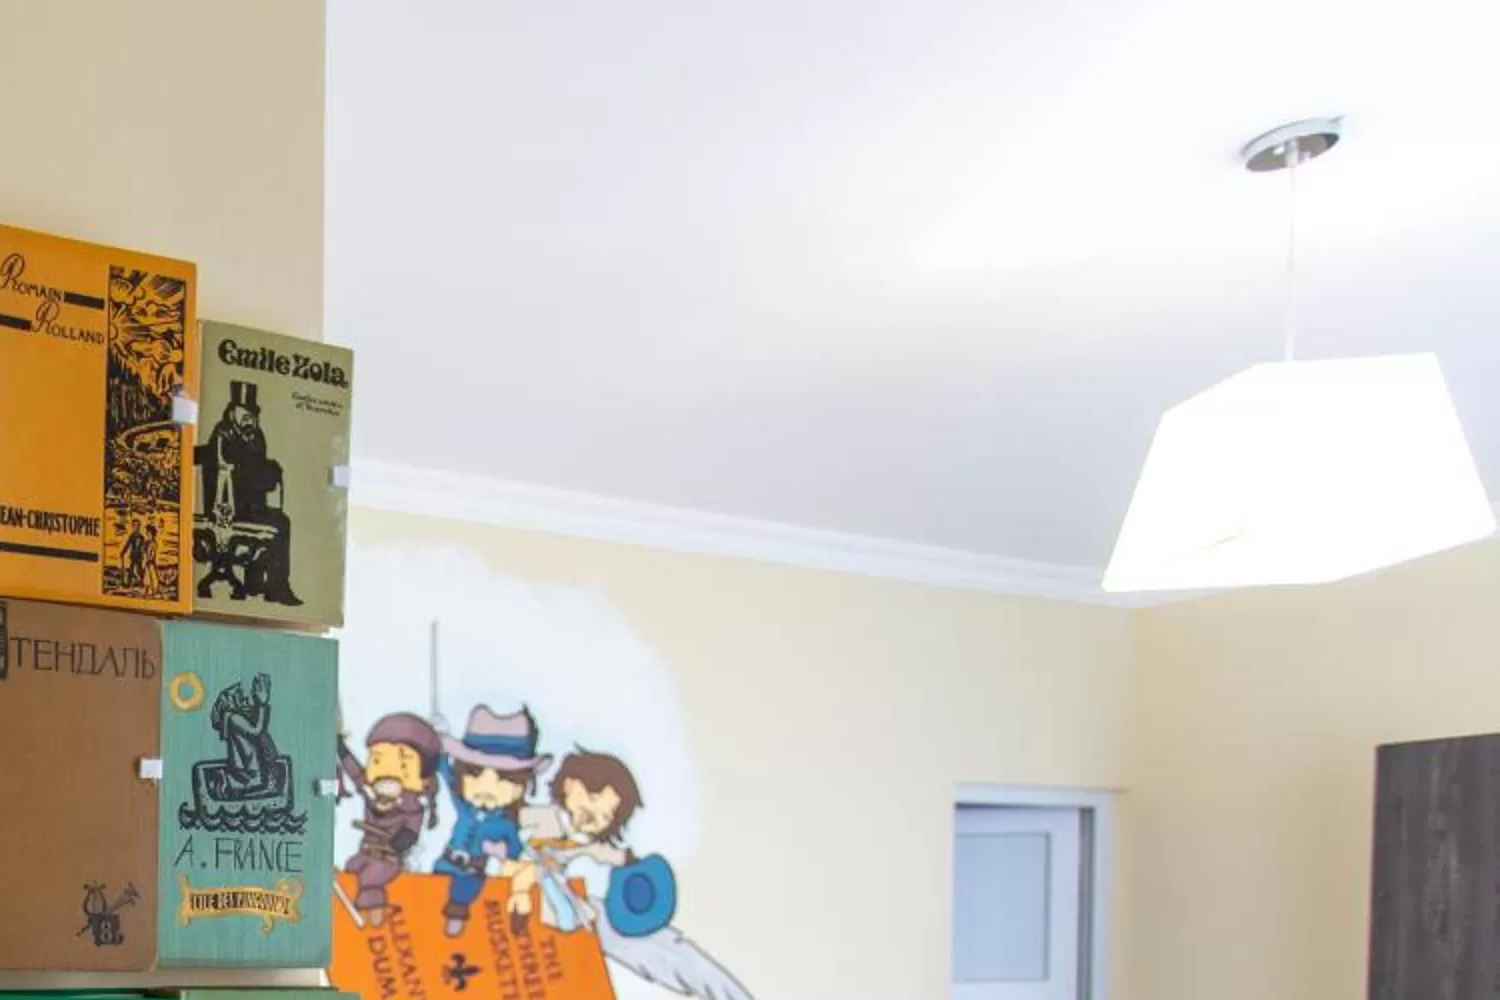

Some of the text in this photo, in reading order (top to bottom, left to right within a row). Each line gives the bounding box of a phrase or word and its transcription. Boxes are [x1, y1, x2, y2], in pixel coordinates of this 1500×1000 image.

[217, 338, 291, 376] Emile
[215, 837, 304, 873] FRANCE
[539, 937, 565, 981] THE
